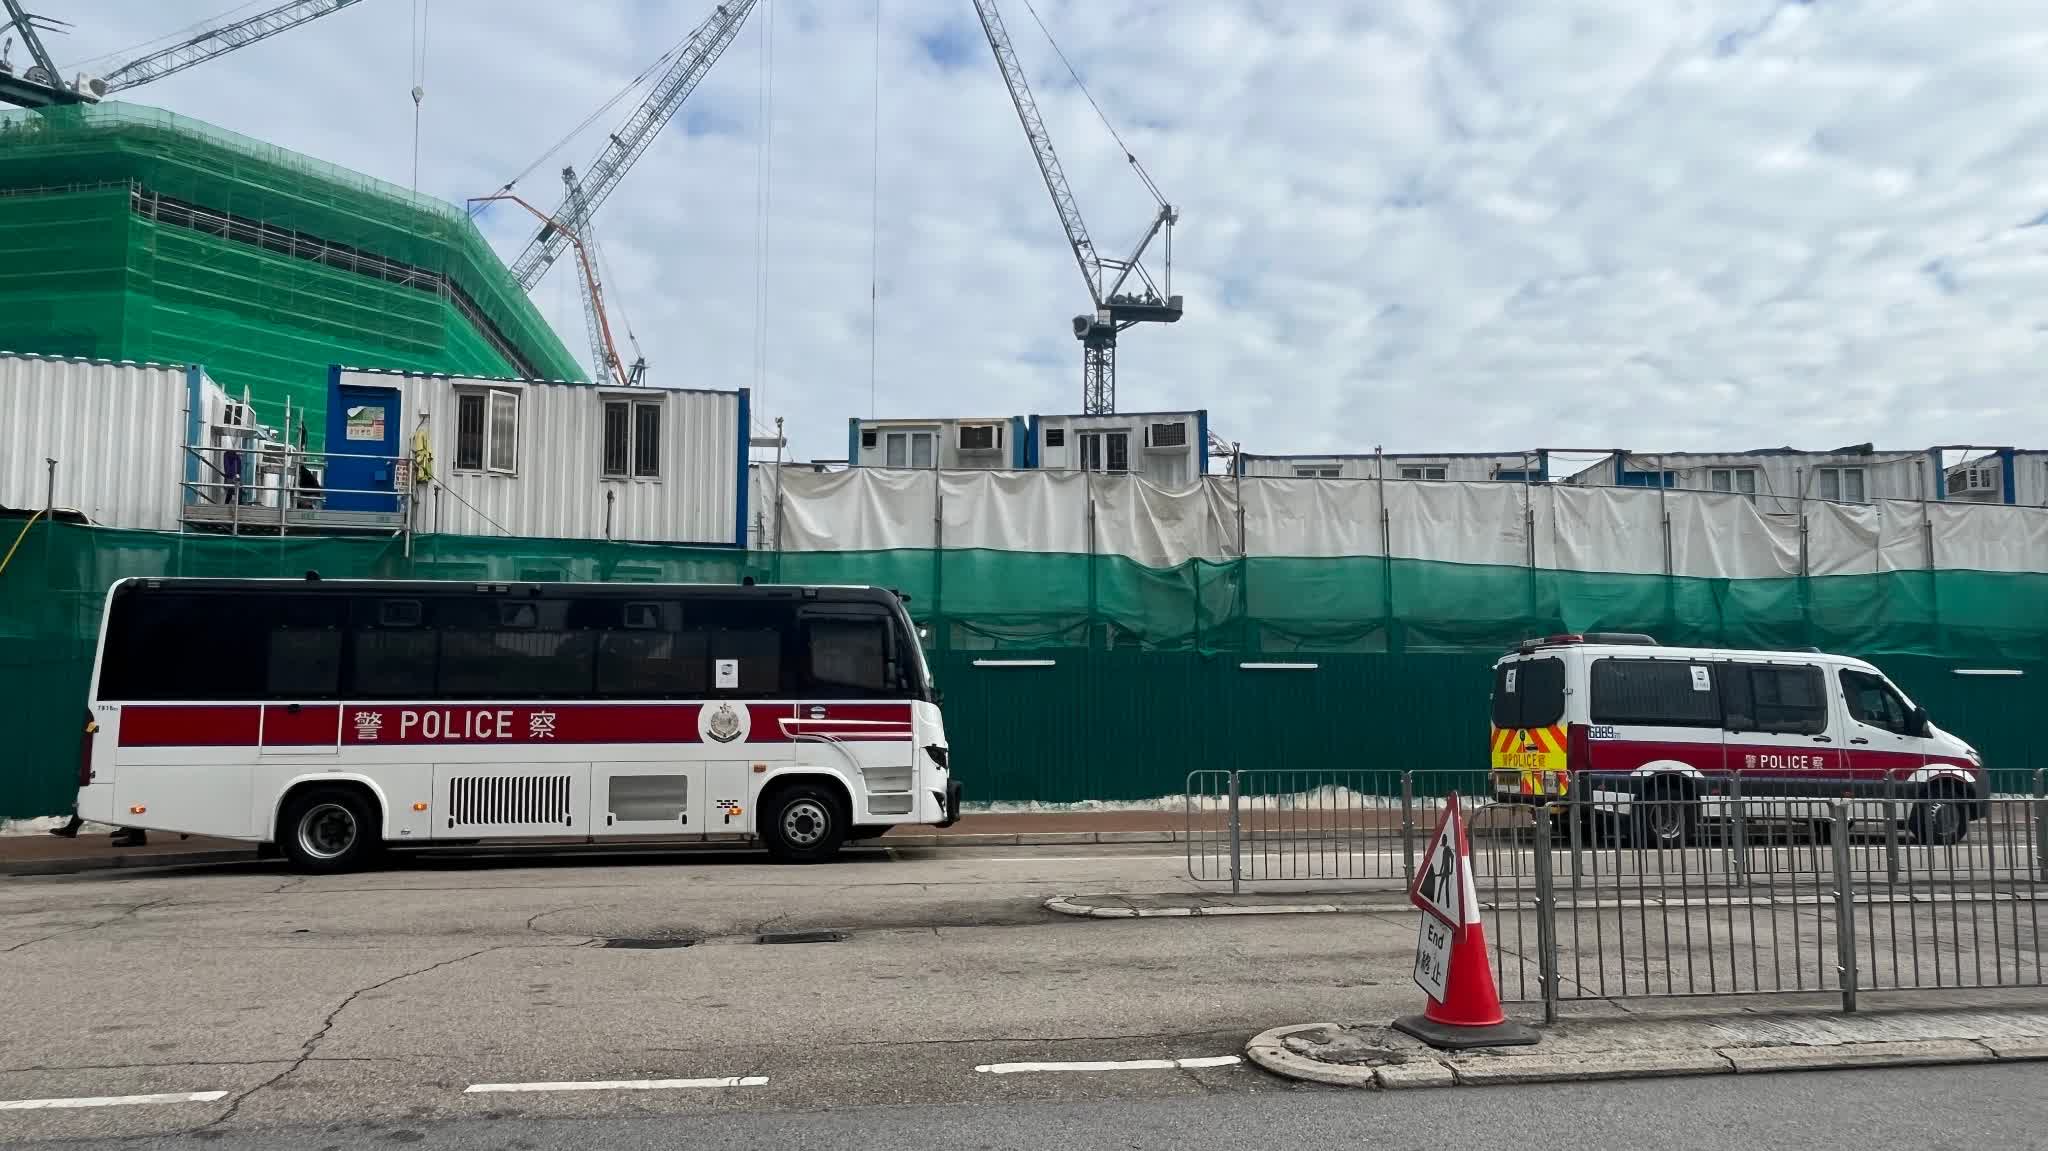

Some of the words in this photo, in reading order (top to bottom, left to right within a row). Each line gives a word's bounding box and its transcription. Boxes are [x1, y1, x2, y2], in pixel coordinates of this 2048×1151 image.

[354, 711, 383, 740] 警
[400, 710, 514, 739] POLICE
[529, 710, 556, 738] 察
[1589, 726, 1614, 739] 6889
[1508, 753, 1537, 768] POLICE
[1760, 754, 1809, 769] POLICE
[1427, 923, 1445, 950] End
[1420, 950, 1442, 987] 終止
